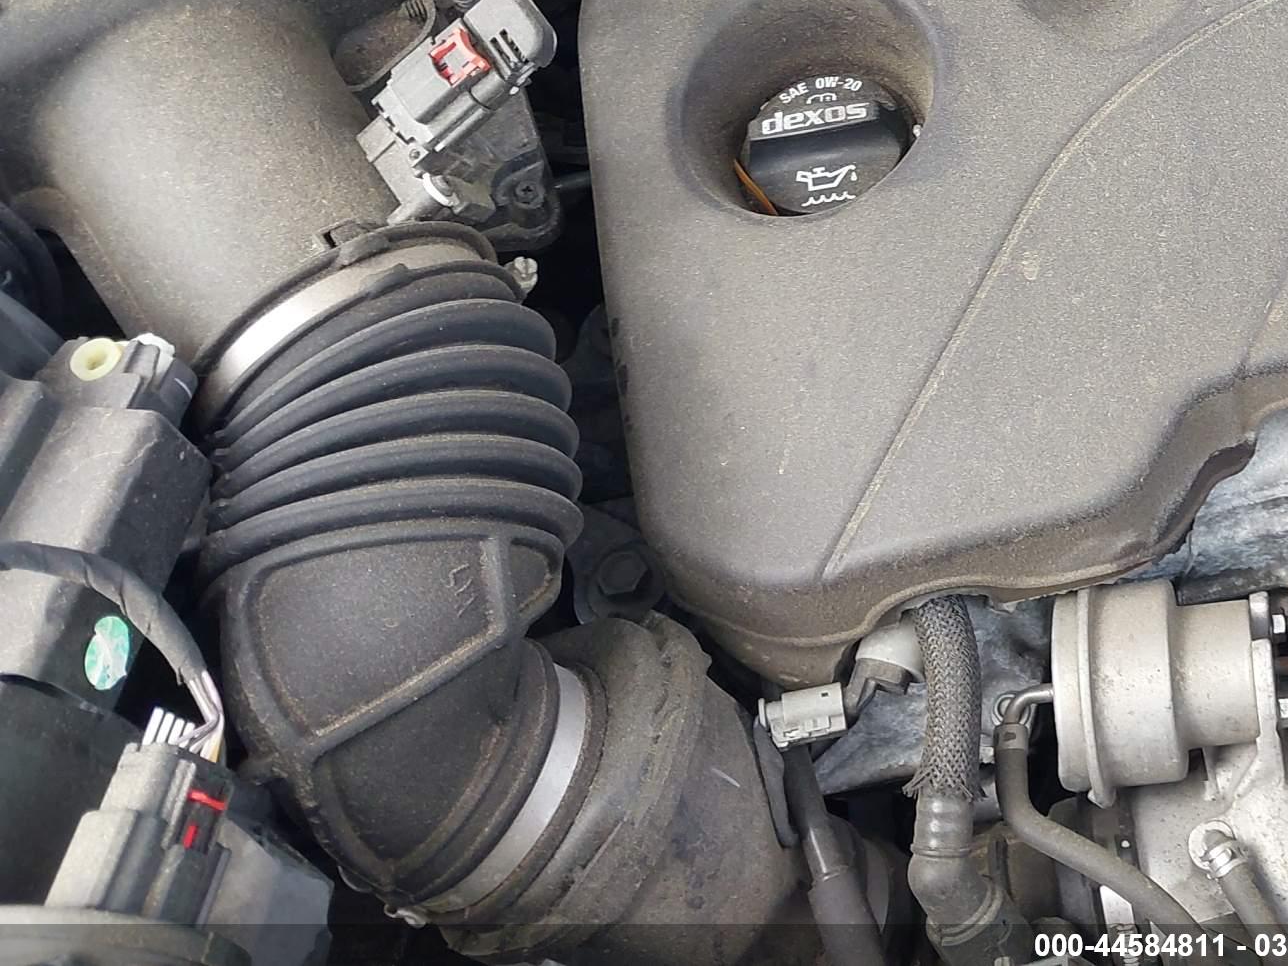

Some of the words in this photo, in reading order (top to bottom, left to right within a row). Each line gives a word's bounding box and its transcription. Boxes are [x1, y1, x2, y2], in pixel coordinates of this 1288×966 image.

[778, 81, 810, 104] SAE
[815, 76, 862, 91] 0W-20
[761, 102, 871, 135] dexos
